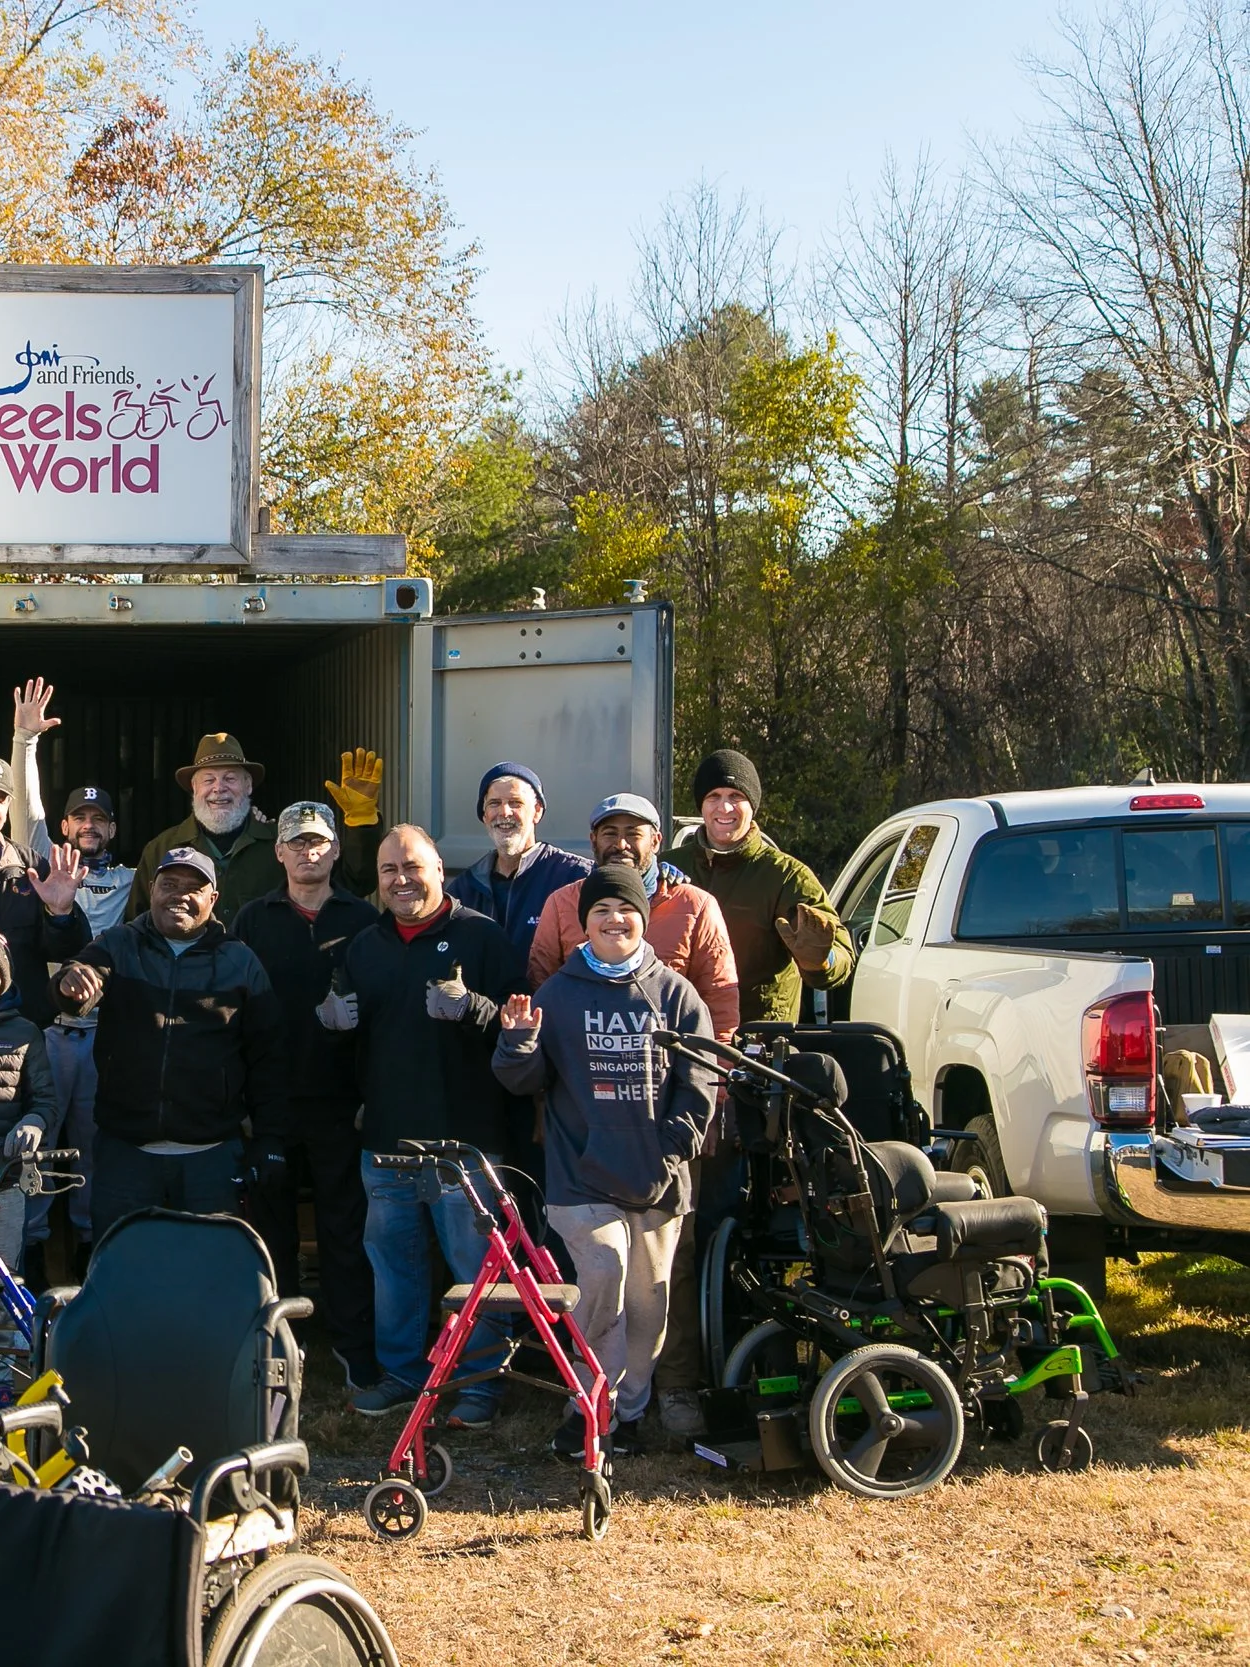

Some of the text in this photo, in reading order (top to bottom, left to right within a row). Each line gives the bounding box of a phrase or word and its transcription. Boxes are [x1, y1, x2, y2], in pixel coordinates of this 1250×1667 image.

[36, 365, 135, 385] and Friends
[0, 443, 159, 494] World
[84, 788, 98, 800] B
[589, 1035, 615, 1049] NO
[620, 1052, 638, 1060] THE
